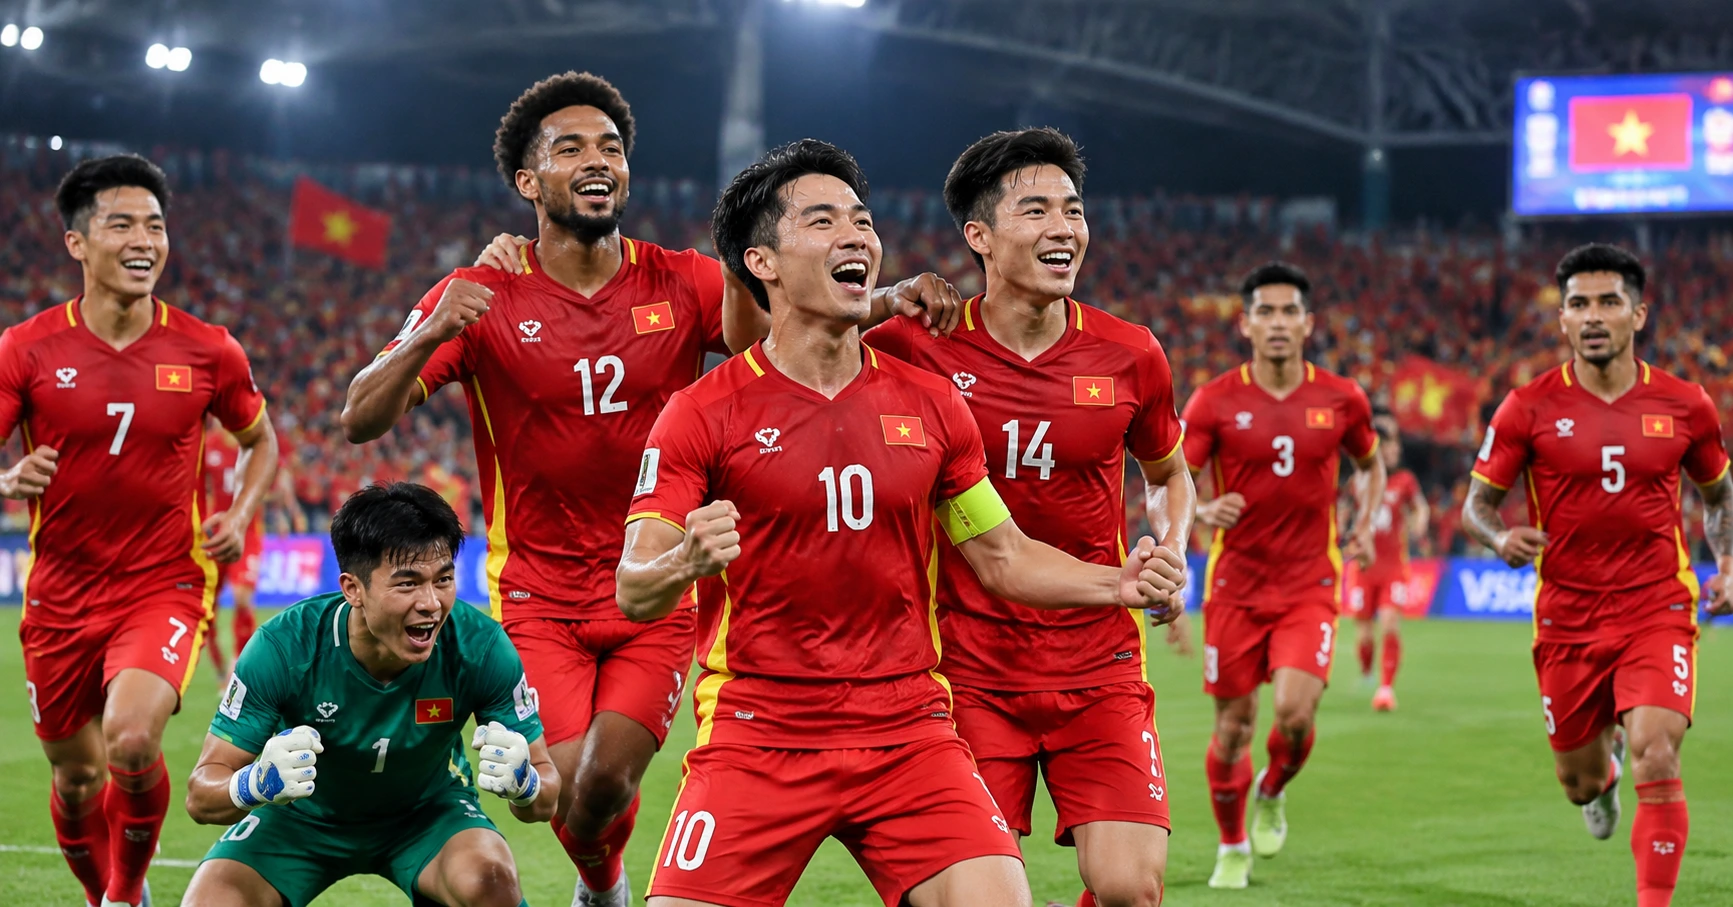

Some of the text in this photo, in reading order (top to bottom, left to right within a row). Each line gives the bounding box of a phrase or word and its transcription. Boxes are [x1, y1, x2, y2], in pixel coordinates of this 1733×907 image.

[573, 354, 628, 415] 12
[106, 403, 135, 455] 7
[1001, 419, 1055, 480] 14
[1272, 435, 1294, 477] 3
[1601, 445, 1625, 493] 5
[818, 463, 873, 532] 10
[168, 617, 187, 648] 7
[1672, 645, 1688, 679] 5
[1542, 695, 1556, 735] 5
[371, 737, 390, 773] 1
[663, 810, 716, 871] 10
